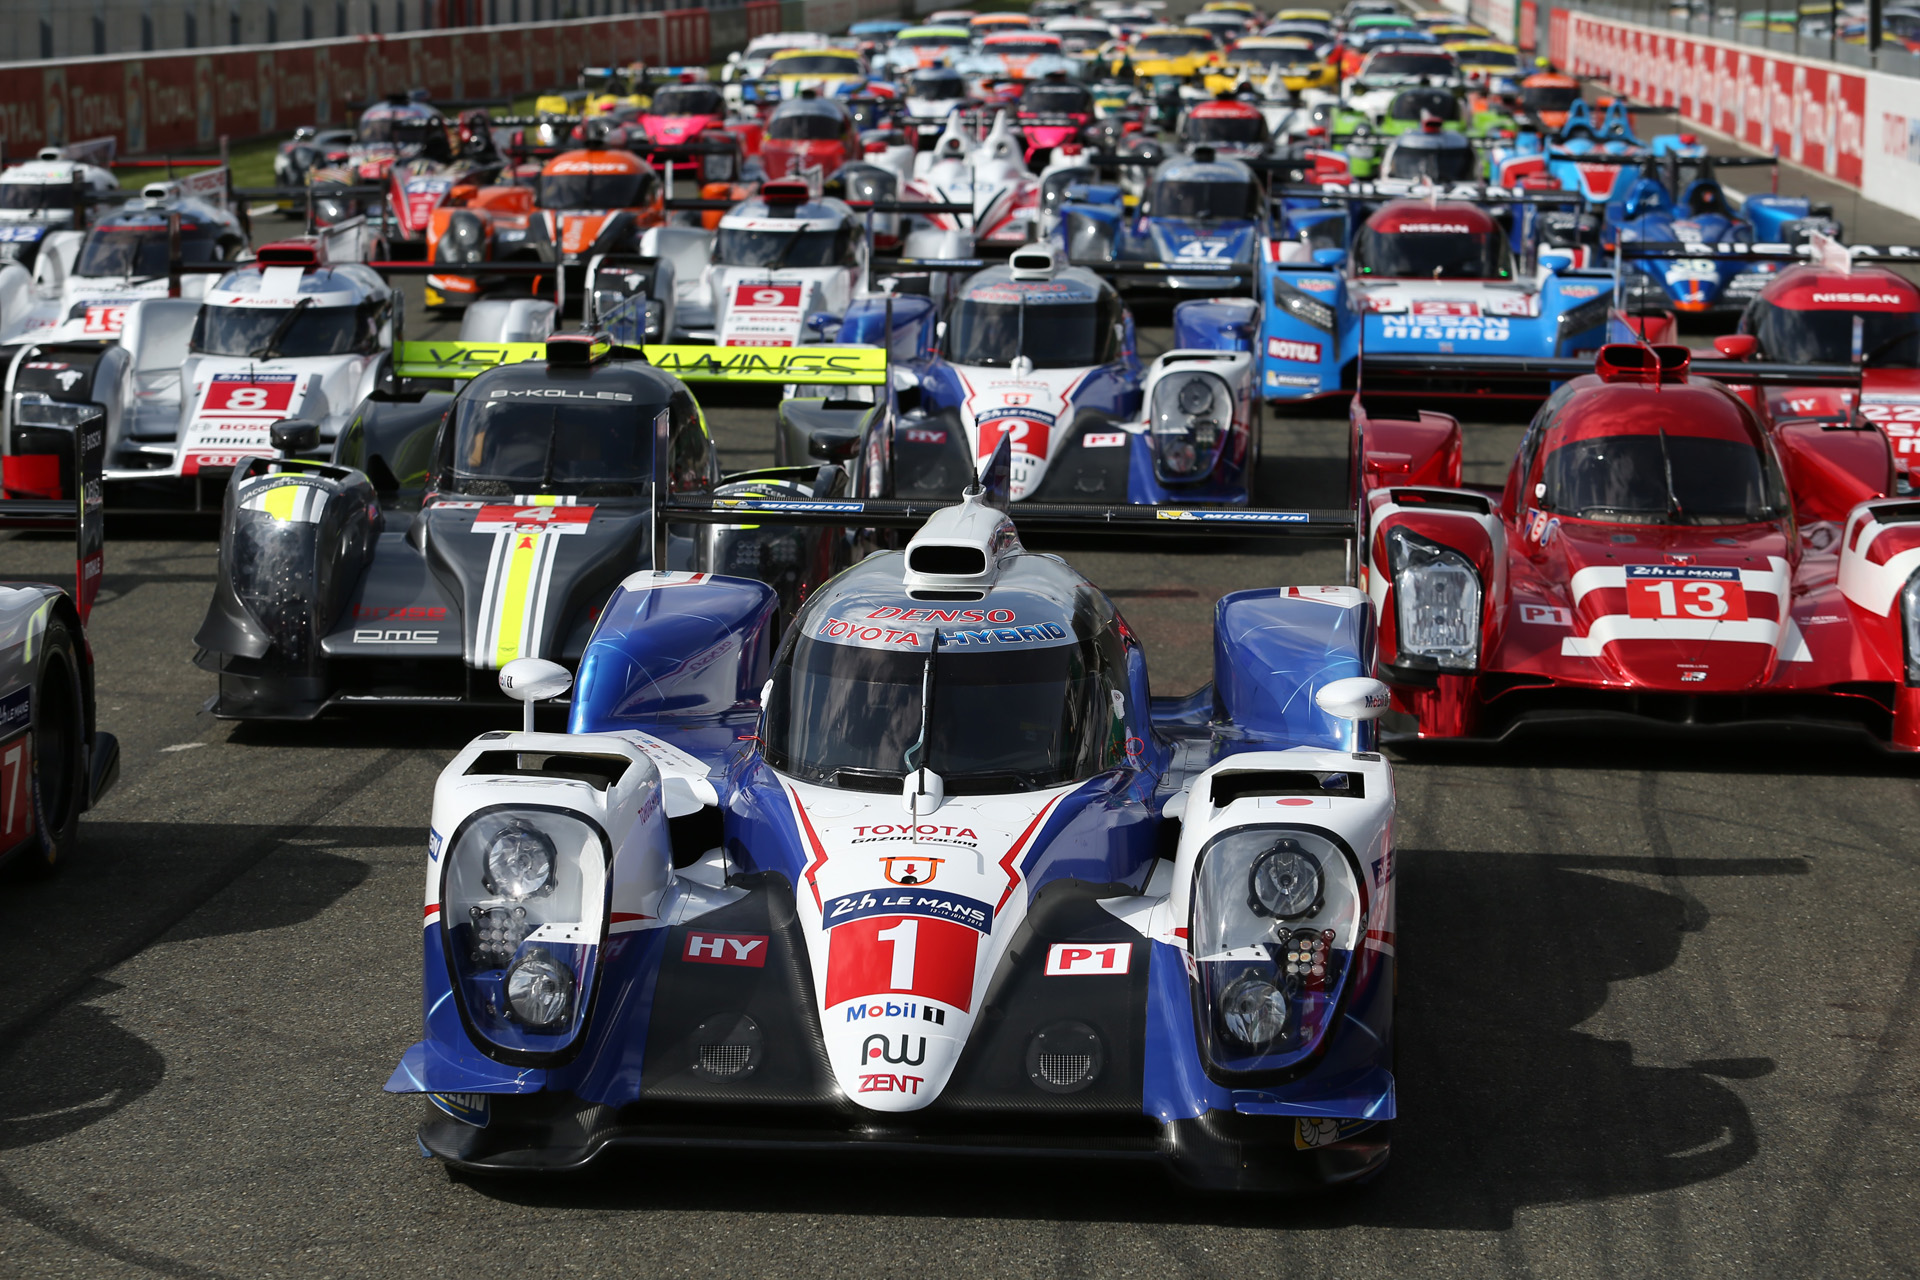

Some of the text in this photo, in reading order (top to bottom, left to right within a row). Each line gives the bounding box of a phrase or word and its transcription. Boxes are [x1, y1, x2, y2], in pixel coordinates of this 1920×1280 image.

[1400, 223, 1469, 233] NISSAN
[1178, 240, 1228, 258] 47
[752, 289, 785, 307] 9
[1812, 293, 1901, 304] NISSAN
[86, 308, 125, 331] 19
[1381, 315, 1511, 329] NISSAN
[1382, 327, 1511, 341] nismo
[1269, 338, 1318, 362] MOTUL
[225, 387, 268, 411] 8
[219, 424, 271, 432] BOSC
[907, 431, 944, 443] HY
[997, 420, 1030, 452] 2
[241, 480, 329, 502] JACQUES LEMANS
[513, 506, 557, 521] 4
[759, 503, 861, 512] MICHELIN
[1202, 513, 1306, 521] MICHELIN
[1666, 570, 1686, 578] LE
[1687, 570, 1733, 579] MANS
[1644, 580, 1729, 618] 13
[352, 602, 447, 619] brose
[865, 606, 1016, 624] DENSO
[1525, 607, 1563, 623] P1
[818, 618, 1068, 647] TOYOTA HYBRID
[853, 824, 979, 840] TOYOTA
[851, 836, 978, 848] GAZOO Racing
[829, 893, 987, 921] 24h LE MANS
[688, 935, 764, 961] HY
[877, 919, 919, 990] 1
[1059, 948, 1116, 970] P1
[846, 1001, 917, 1023] Mobil
[857, 1073, 925, 1095] ZENT
